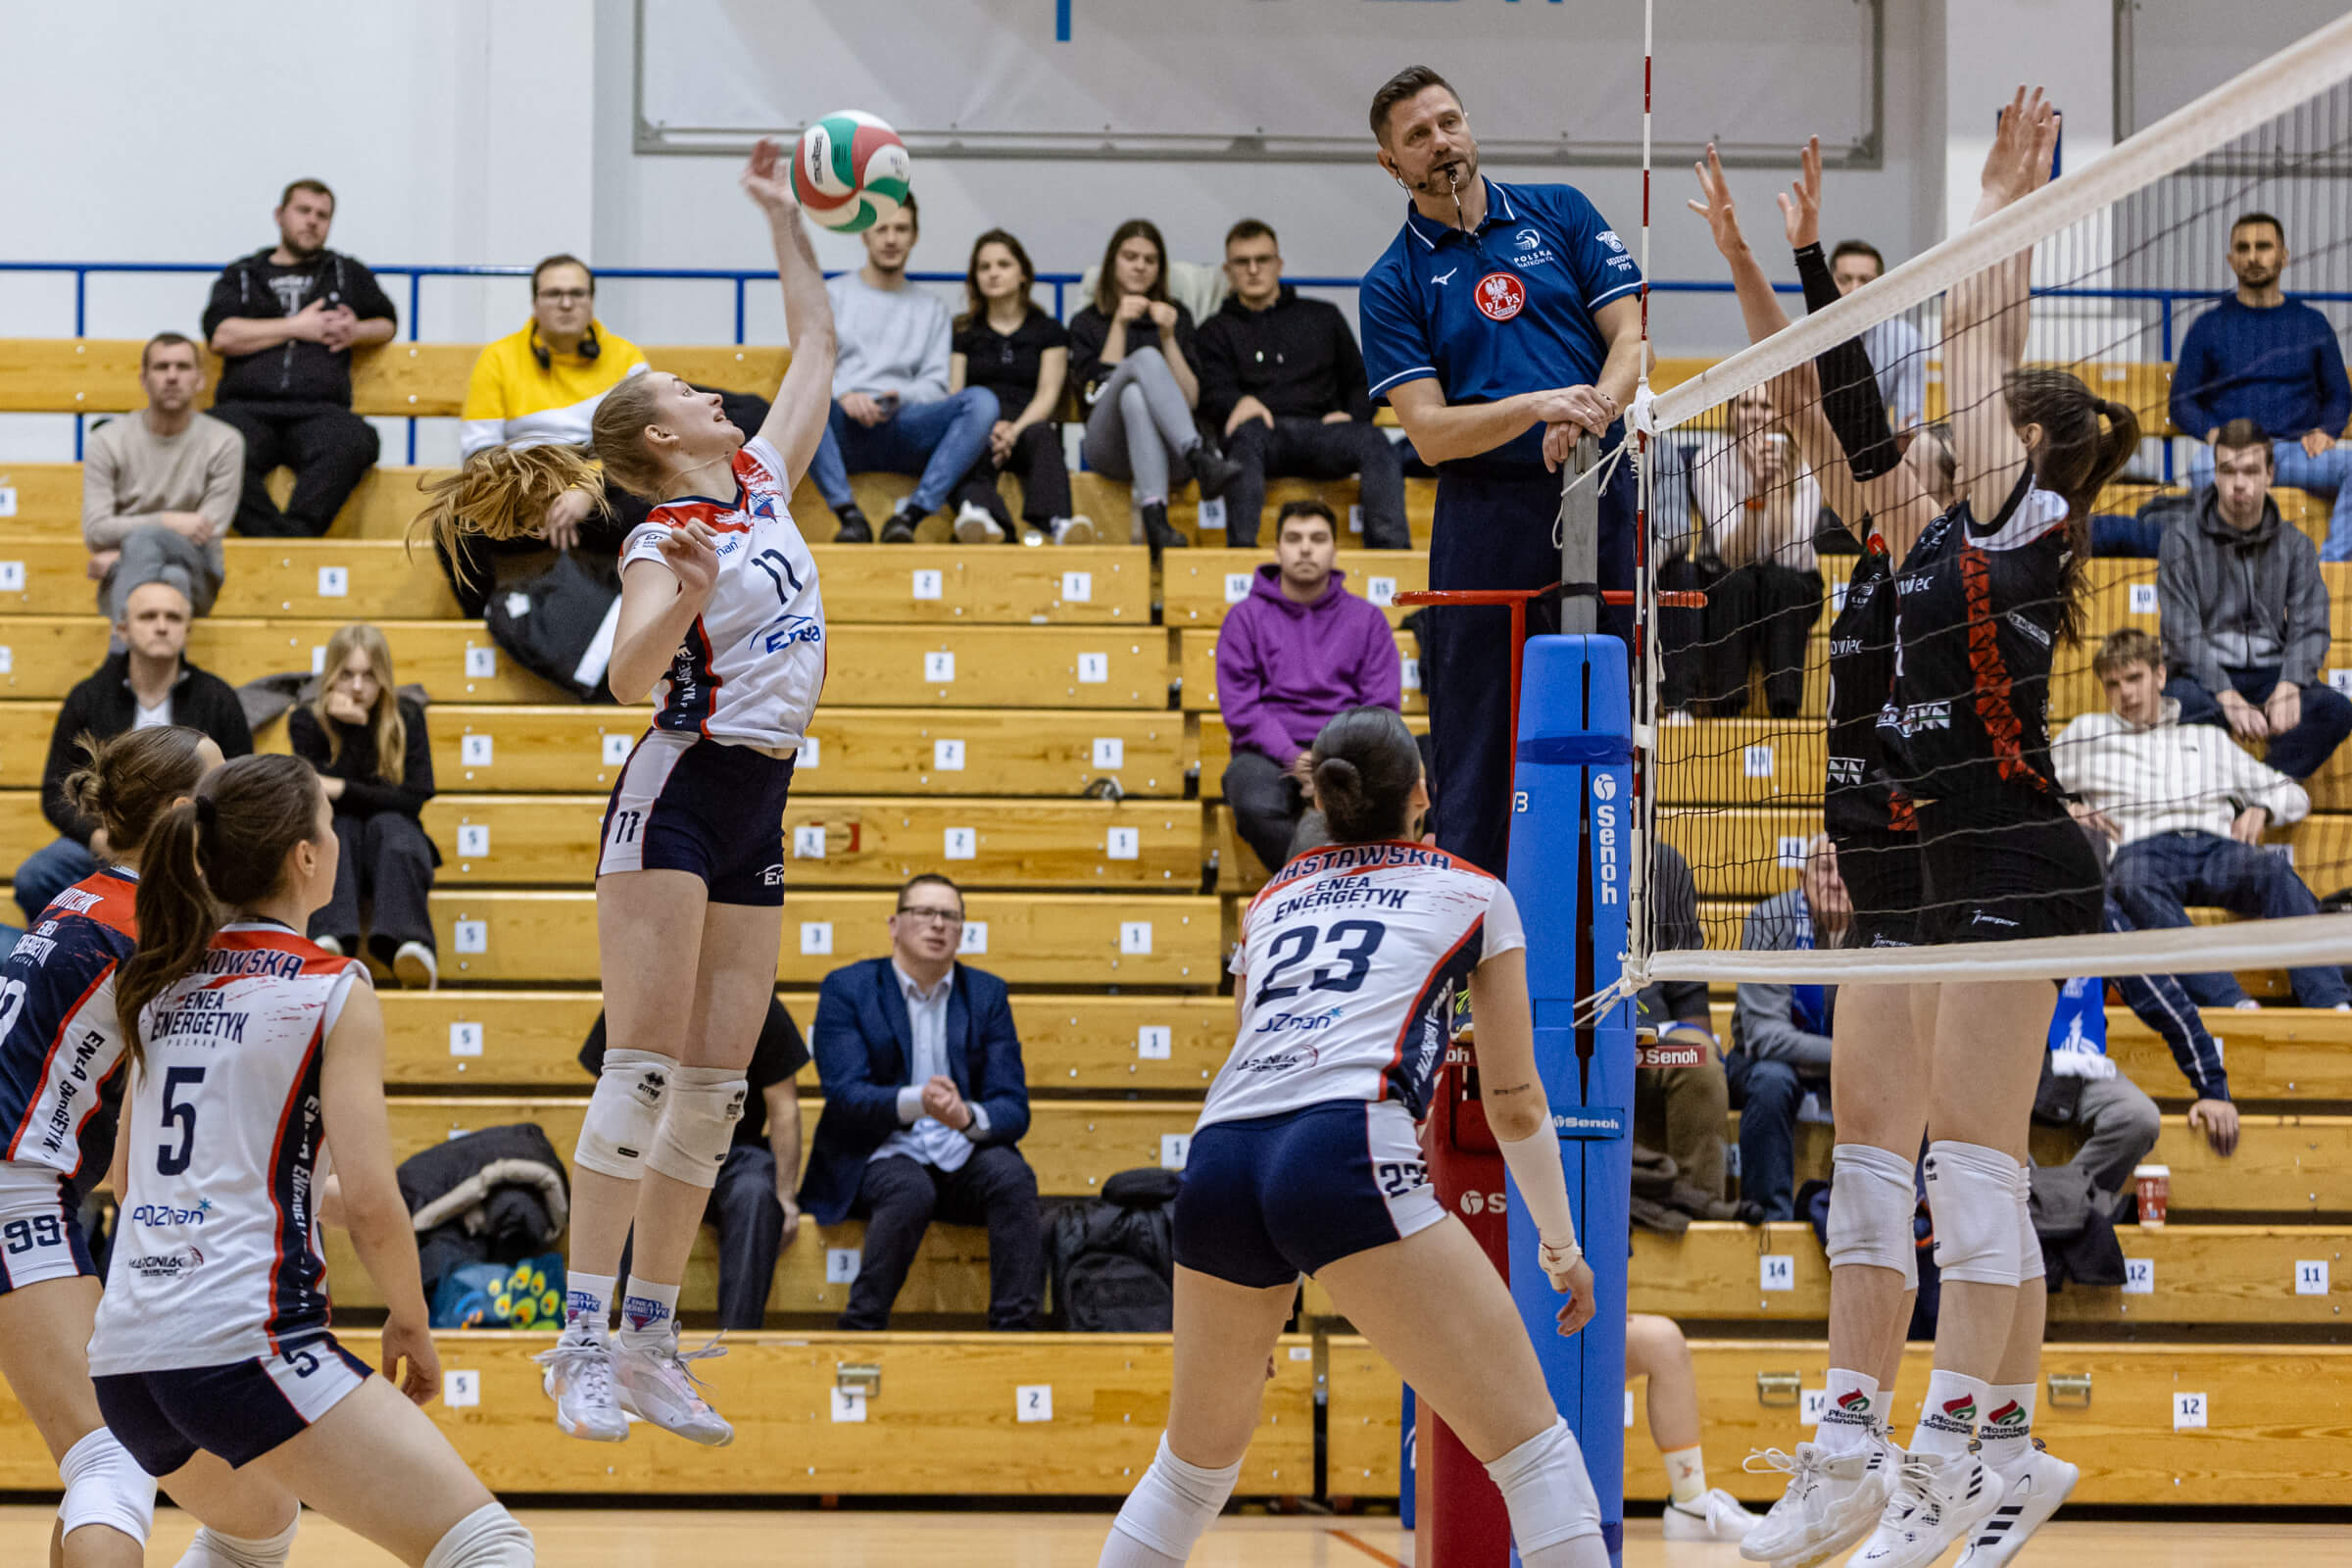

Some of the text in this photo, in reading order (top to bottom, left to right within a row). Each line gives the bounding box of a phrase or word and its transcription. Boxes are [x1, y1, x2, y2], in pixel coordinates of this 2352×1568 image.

[1513, 250, 1553, 264] POLSKA
[1486, 295, 1522, 313] PZ PS
[752, 549, 803, 605] 11
[2337, 674, 2346, 688] 9
[613, 740, 622, 754] 4
[615, 811, 640, 844] 11
[1596, 805, 1618, 906] Senoh
[1314, 876, 1371, 893] ENEA
[1274, 888, 1410, 923] ENERGETYK
[202, 948, 306, 981] KOWSKA
[1254, 919, 1387, 1009] 23
[183, 991, 226, 1010] ENEA
[151, 1012, 250, 1044] ENERGETYK
[461, 1028, 471, 1046] 5
[1152, 1032, 1158, 1049] 1
[1645, 1048, 1698, 1065] Senoh
[157, 1066, 206, 1176] 5
[1565, 1115, 1620, 1130] Senoh
[1173, 1141, 1182, 1158] 1
[4, 1214, 64, 1254] 99
[1769, 1261, 1787, 1278] 14
[2129, 1265, 2147, 1281] 12
[2304, 1267, 2321, 1283] 11
[282, 1350, 320, 1379] 5
[456, 1376, 467, 1395] 5
[846, 1395, 856, 1409] 3
[1029, 1392, 1040, 1409] 2
[2181, 1398, 2200, 1415] 12
